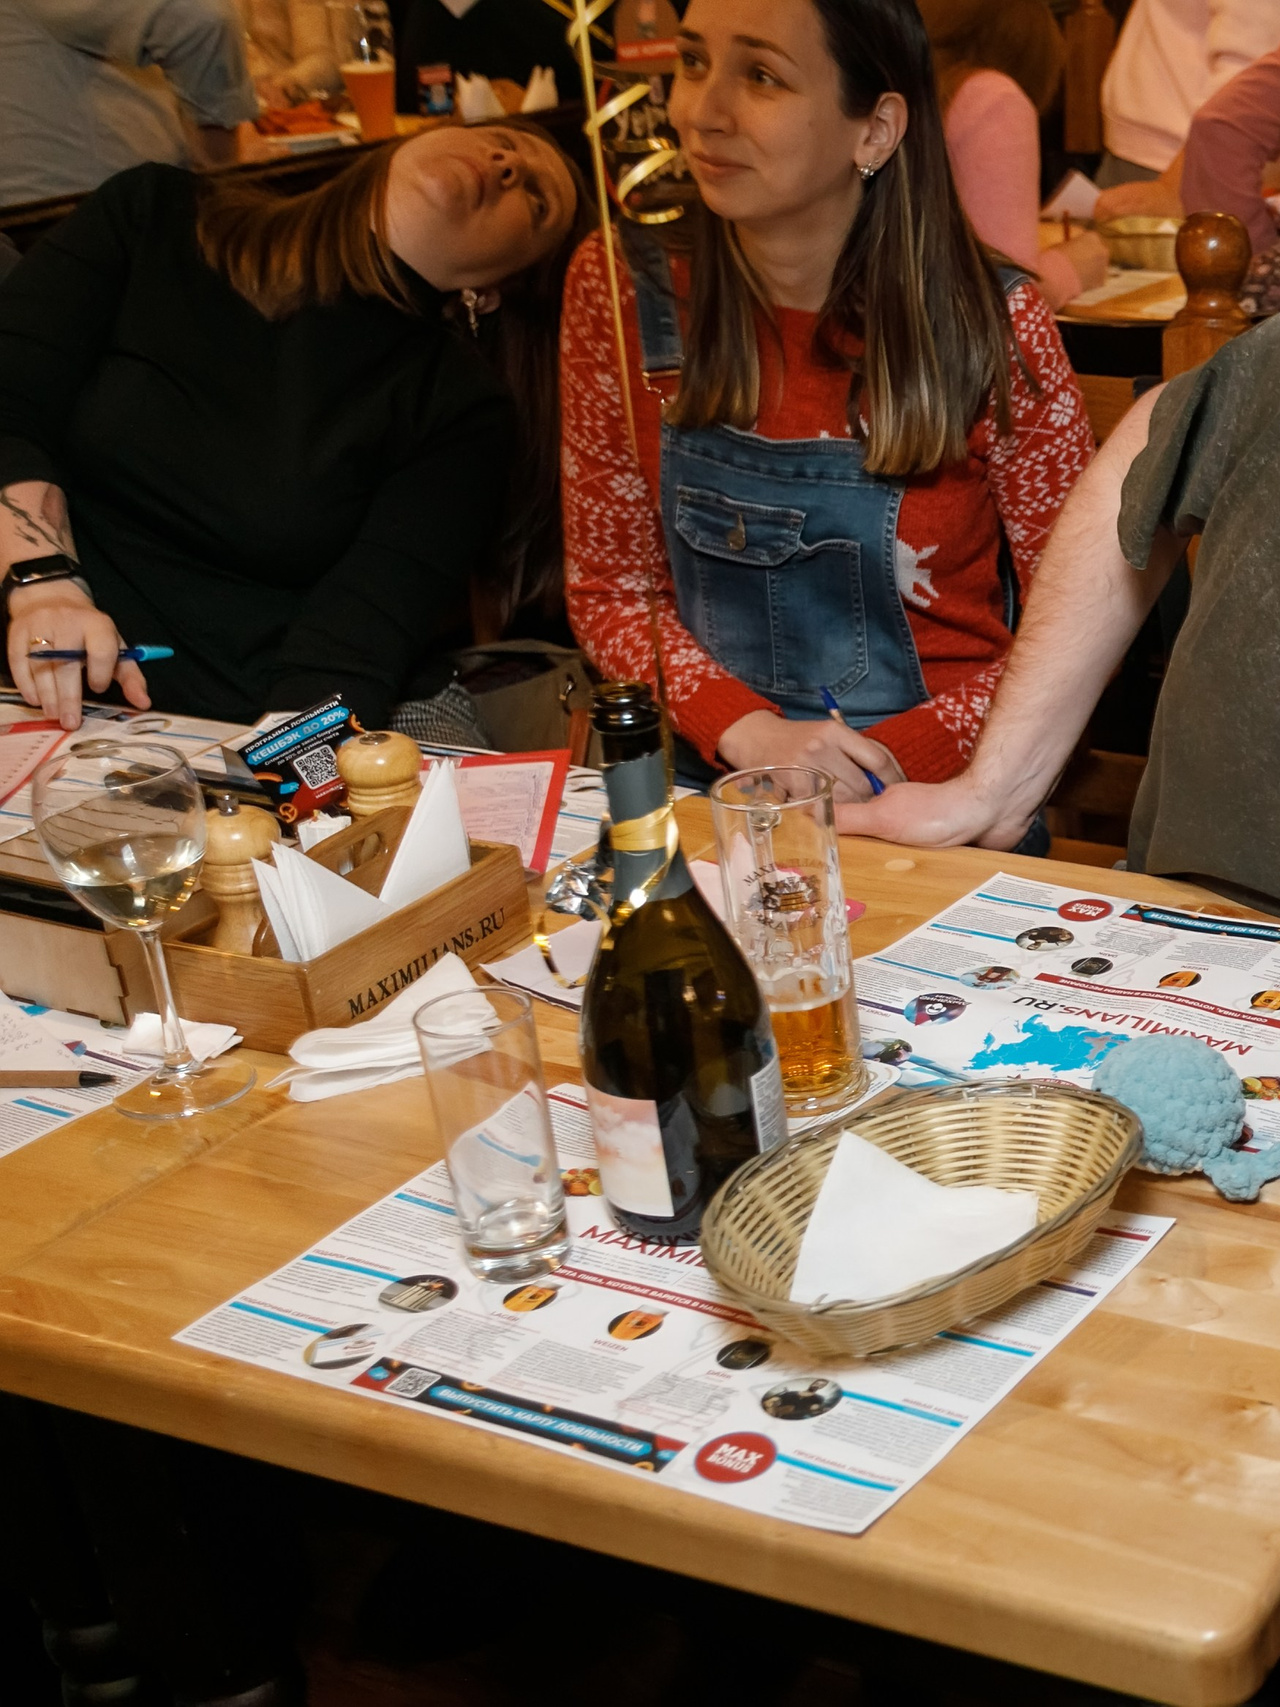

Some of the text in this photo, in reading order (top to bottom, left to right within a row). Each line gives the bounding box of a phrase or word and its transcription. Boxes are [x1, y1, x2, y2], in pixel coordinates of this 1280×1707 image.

[245, 700, 340, 753] ПРОГРАММА ЛОЯЛЬНОСТИ
[316, 723, 345, 738] бонусами
[251, 709, 346, 763] КЕШБЭК ДО 20%
[1067, 908, 1101, 917] MAX
[1071, 903, 1106, 911] BONUS
[1150, 912, 1215, 929] ЛОЯЛЬНОСТИ
[1215, 923, 1247, 933] КАРТУ
[1059, 978, 1103, 993] РЕСТОРАНЕ
[1103, 986, 1133, 996] НАШЕМ
[1139, 991, 1175, 1002] ВАРЯТСЯ
[1175, 996, 1215, 1011] КОТОРЫЕ
[1216, 1006, 1242, 1017] ПИВА,
[1241, 1013, 1269, 1023] СОРТА
[577, 1271, 605, 1285] ПИВА,
[605, 1279, 650, 1296] КОТОРЫЕ
[649, 1288, 693, 1306] ВАРЯТСЯ
[490, 1311, 520, 1322] LAGER
[593, 1338, 629, 1352] WEIZEN
[438, 1387, 646, 1452] ВЫПУСТИТЬ КАРТУ ЛОЯЛЬНОСТИ
[714, 1443, 765, 1464] MAX
[706, 1453, 756, 1474] BONUS
